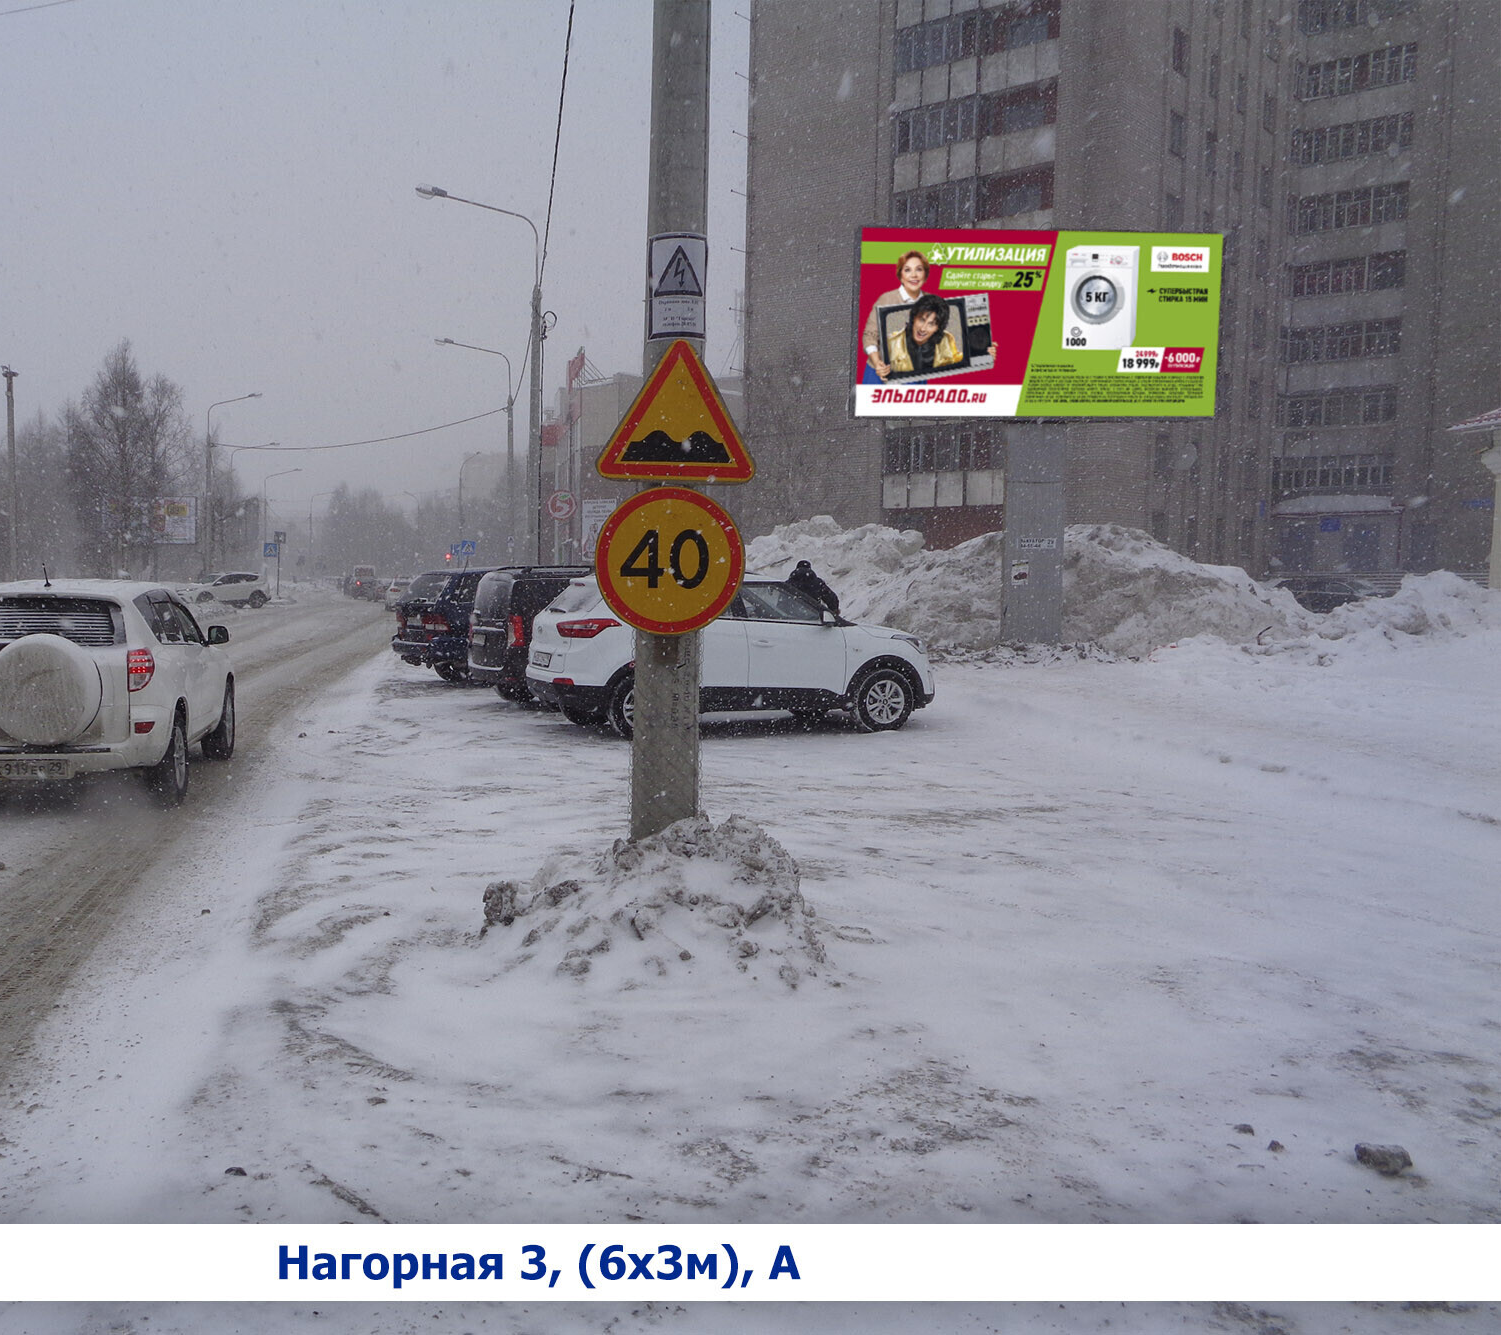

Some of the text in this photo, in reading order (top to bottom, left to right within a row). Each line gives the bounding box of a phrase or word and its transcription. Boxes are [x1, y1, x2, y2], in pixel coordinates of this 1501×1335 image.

[947, 247, 1046, 264] УТИЛИЗАЦИЯ
[1172, 253, 1203, 262] BOSCH
[1086, 292, 1108, 302] 5 КГ
[1065, 338, 1087, 347] 1000
[1122, 358, 1135, 369] 18
[620, 529, 709, 589] 40
[49, 762, 62, 772] 29
